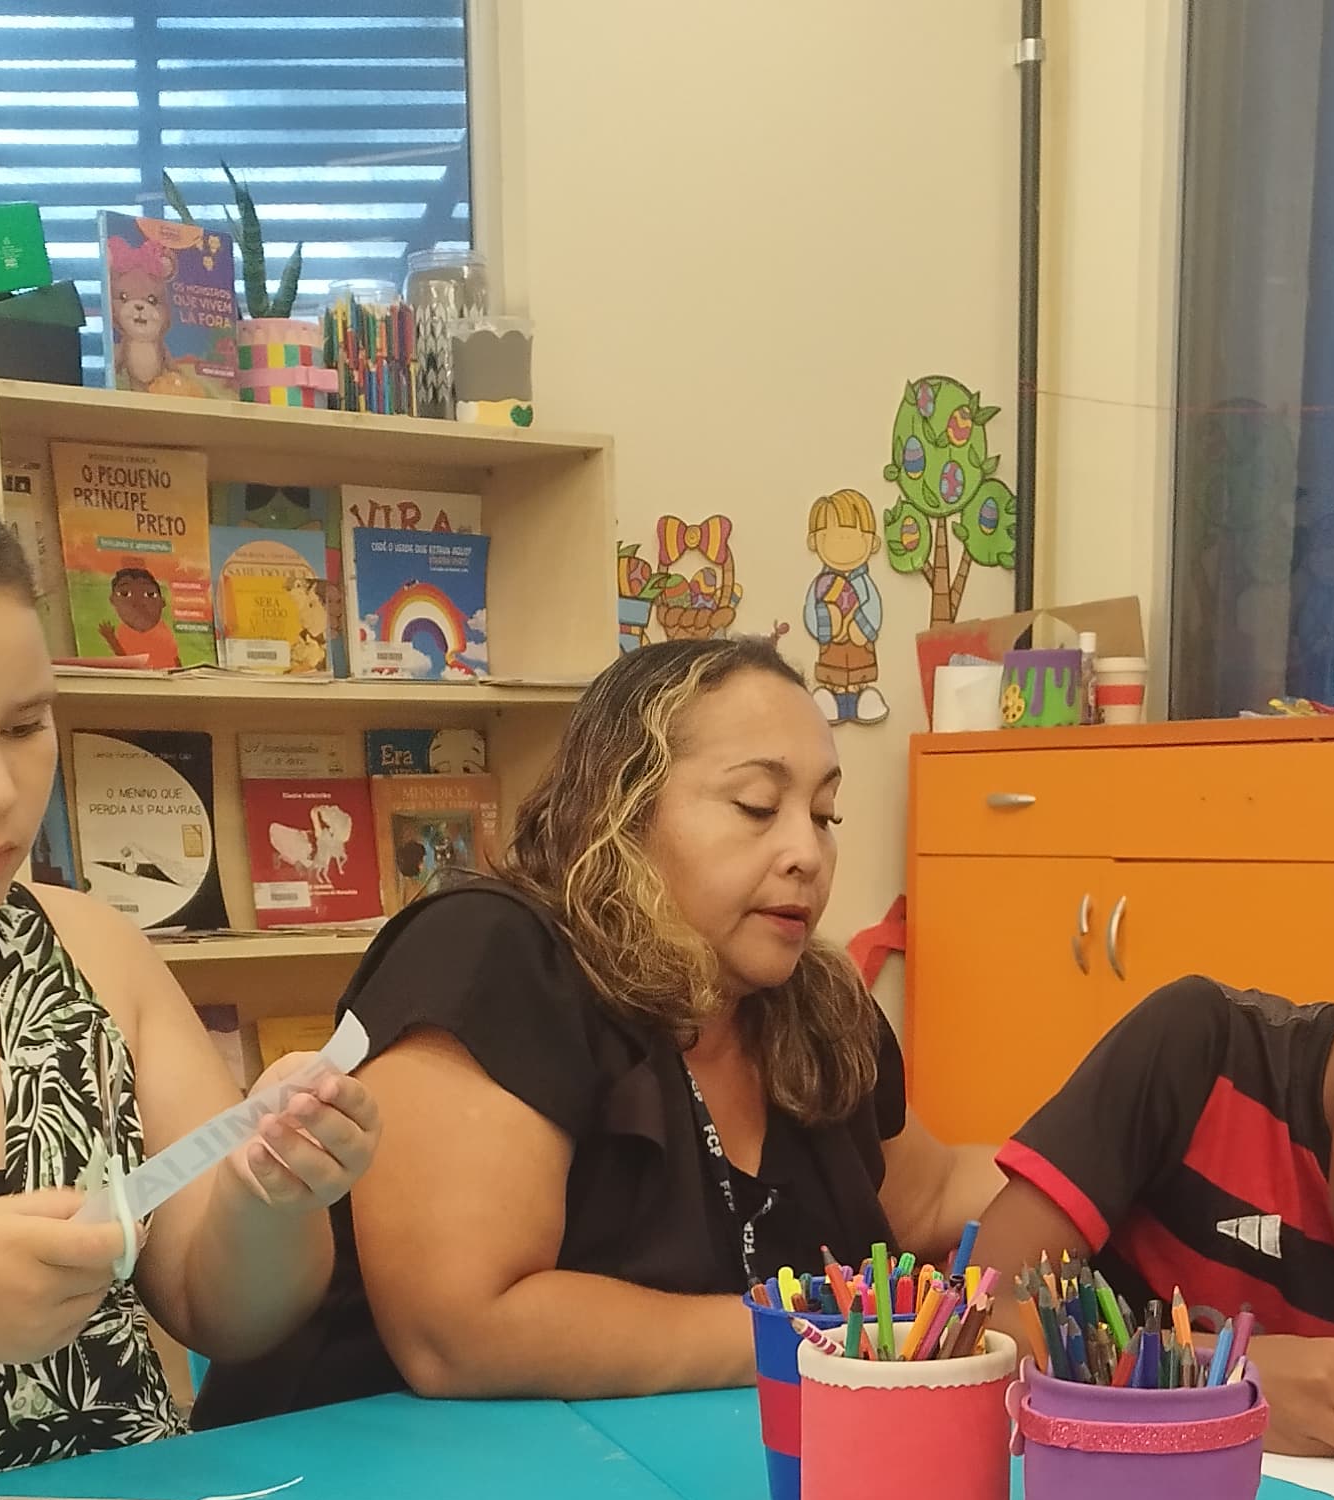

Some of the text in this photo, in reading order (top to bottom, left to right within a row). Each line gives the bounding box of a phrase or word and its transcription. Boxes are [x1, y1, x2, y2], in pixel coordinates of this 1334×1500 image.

[199, 312, 233, 329] FORA
[81, 464, 172, 489] O PEQUENO
[136, 513, 186, 536] PRETO
[380, 743, 414, 766] Era
[119, 787, 157, 800] MENINO
[161, 788, 183, 800] QUE
[90, 803, 203, 817] PERDIA AS PALAVRAS
[703, 1123, 723, 1158] FCP
[743, 1220, 756, 1255] FCP
